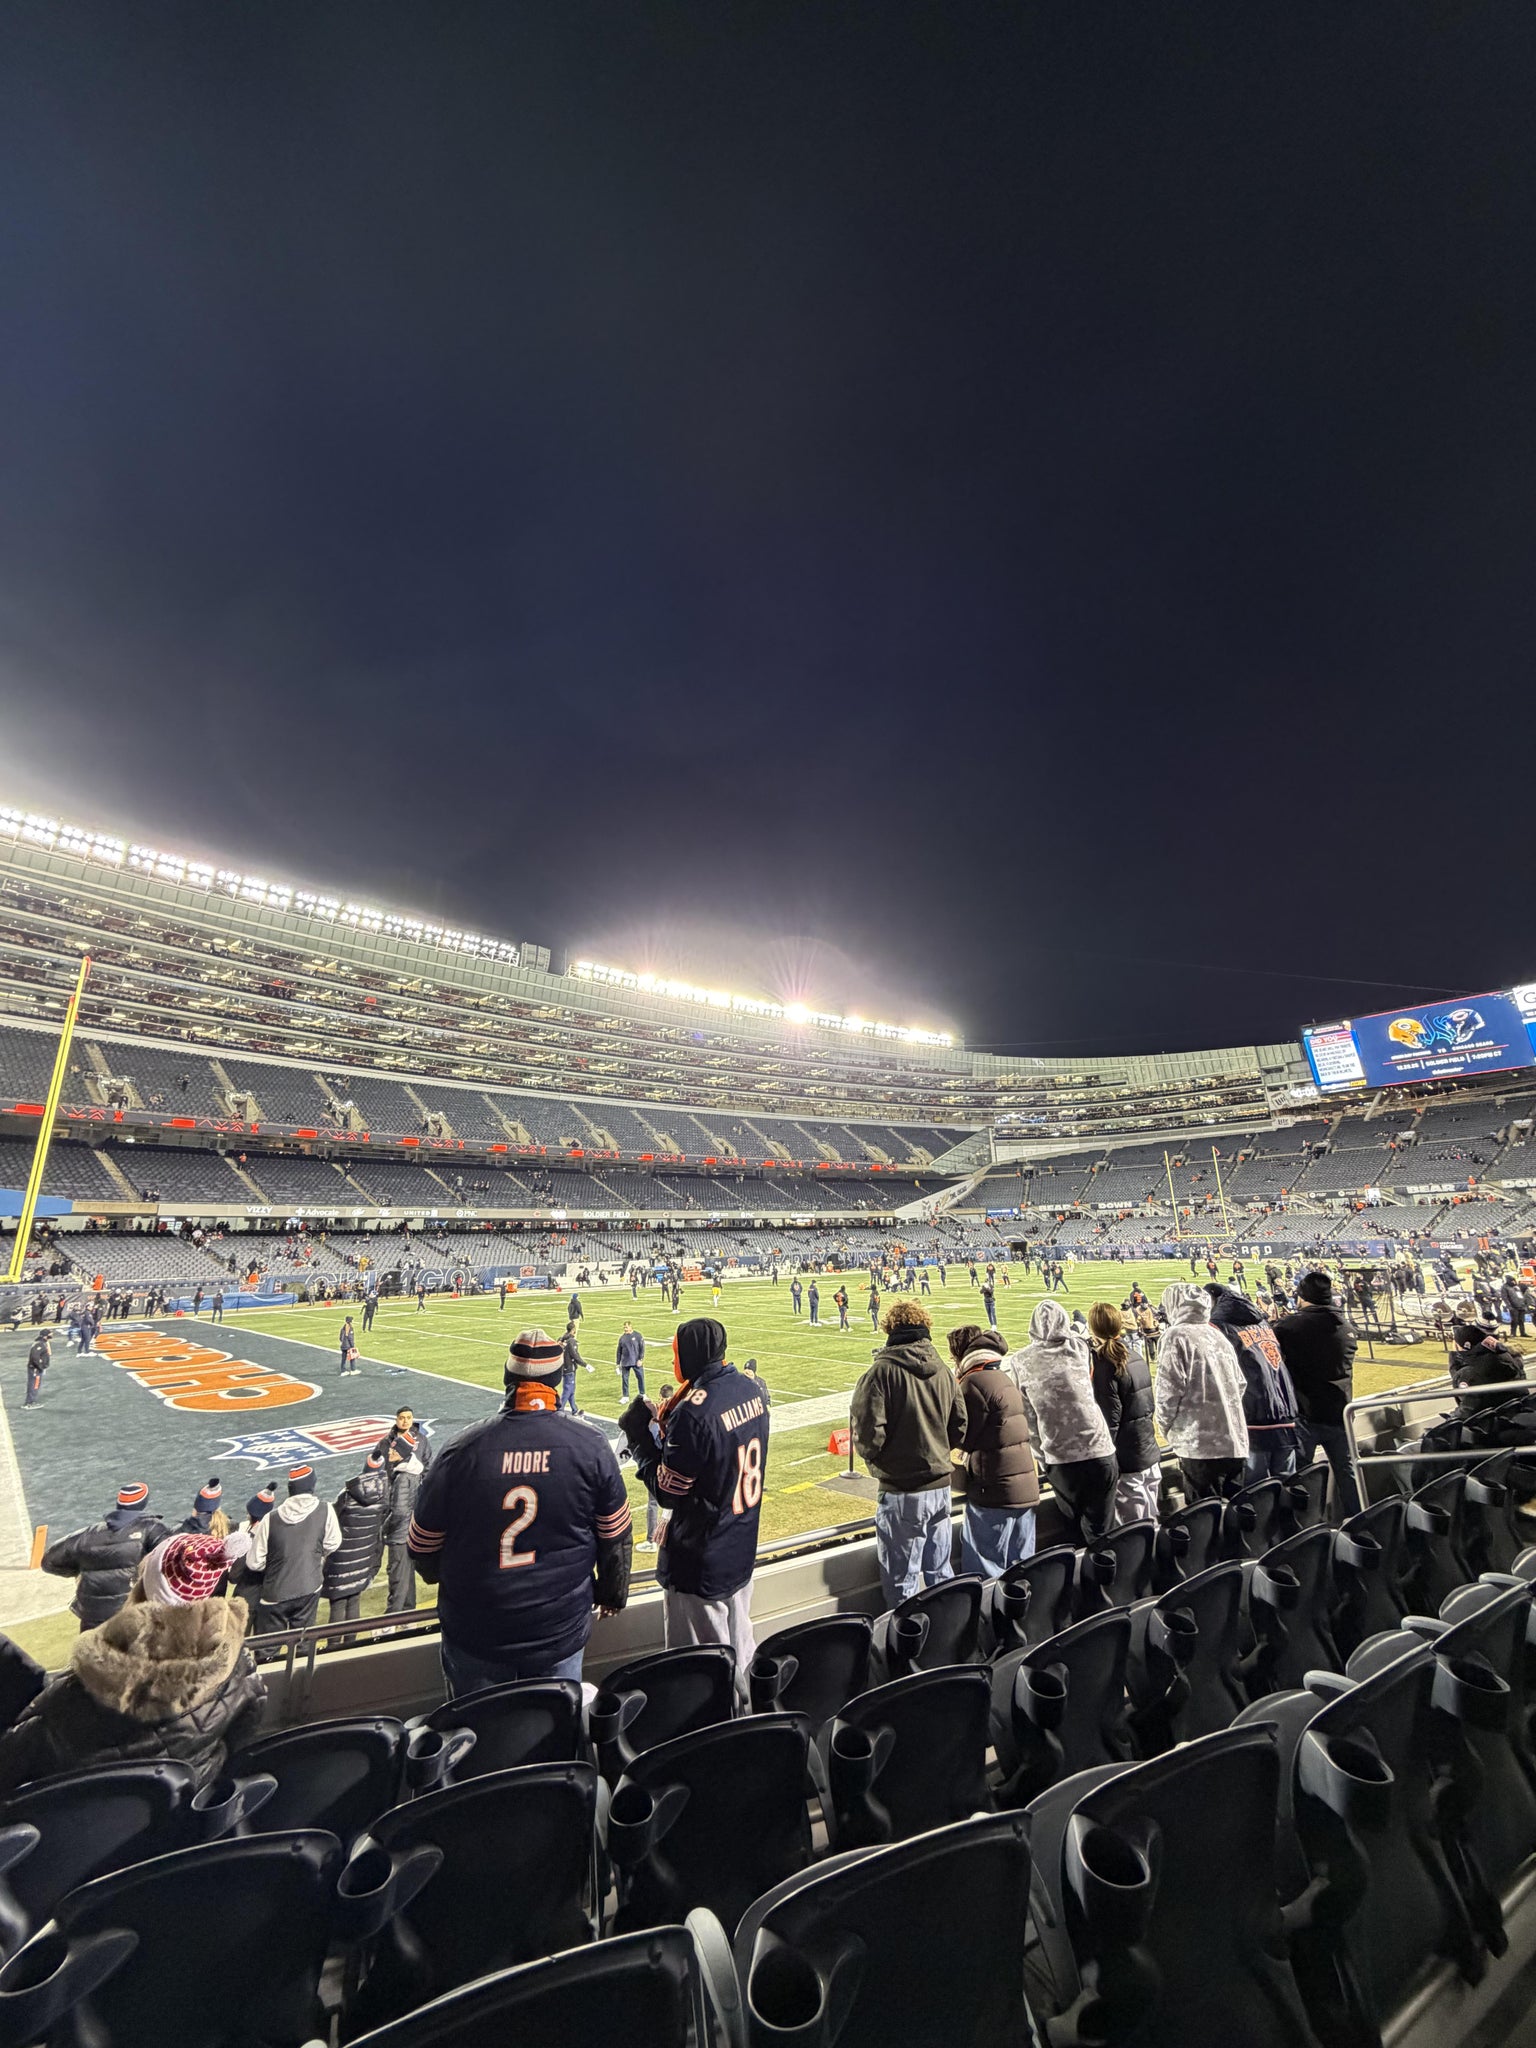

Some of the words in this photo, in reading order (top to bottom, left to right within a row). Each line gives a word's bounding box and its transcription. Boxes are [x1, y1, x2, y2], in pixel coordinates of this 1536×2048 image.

[246, 1206, 273, 1214] VIZZY
[305, 1208, 340, 1217] Advocate
[583, 1210, 610, 1218] SOLDIER
[613, 1210, 631, 1218] FIELD
[720, 1396, 764, 1432] WILLIAMS
[502, 1450, 551, 1475] MOORE
[732, 1437, 762, 1515] 18
[499, 1485, 538, 1569] 2
